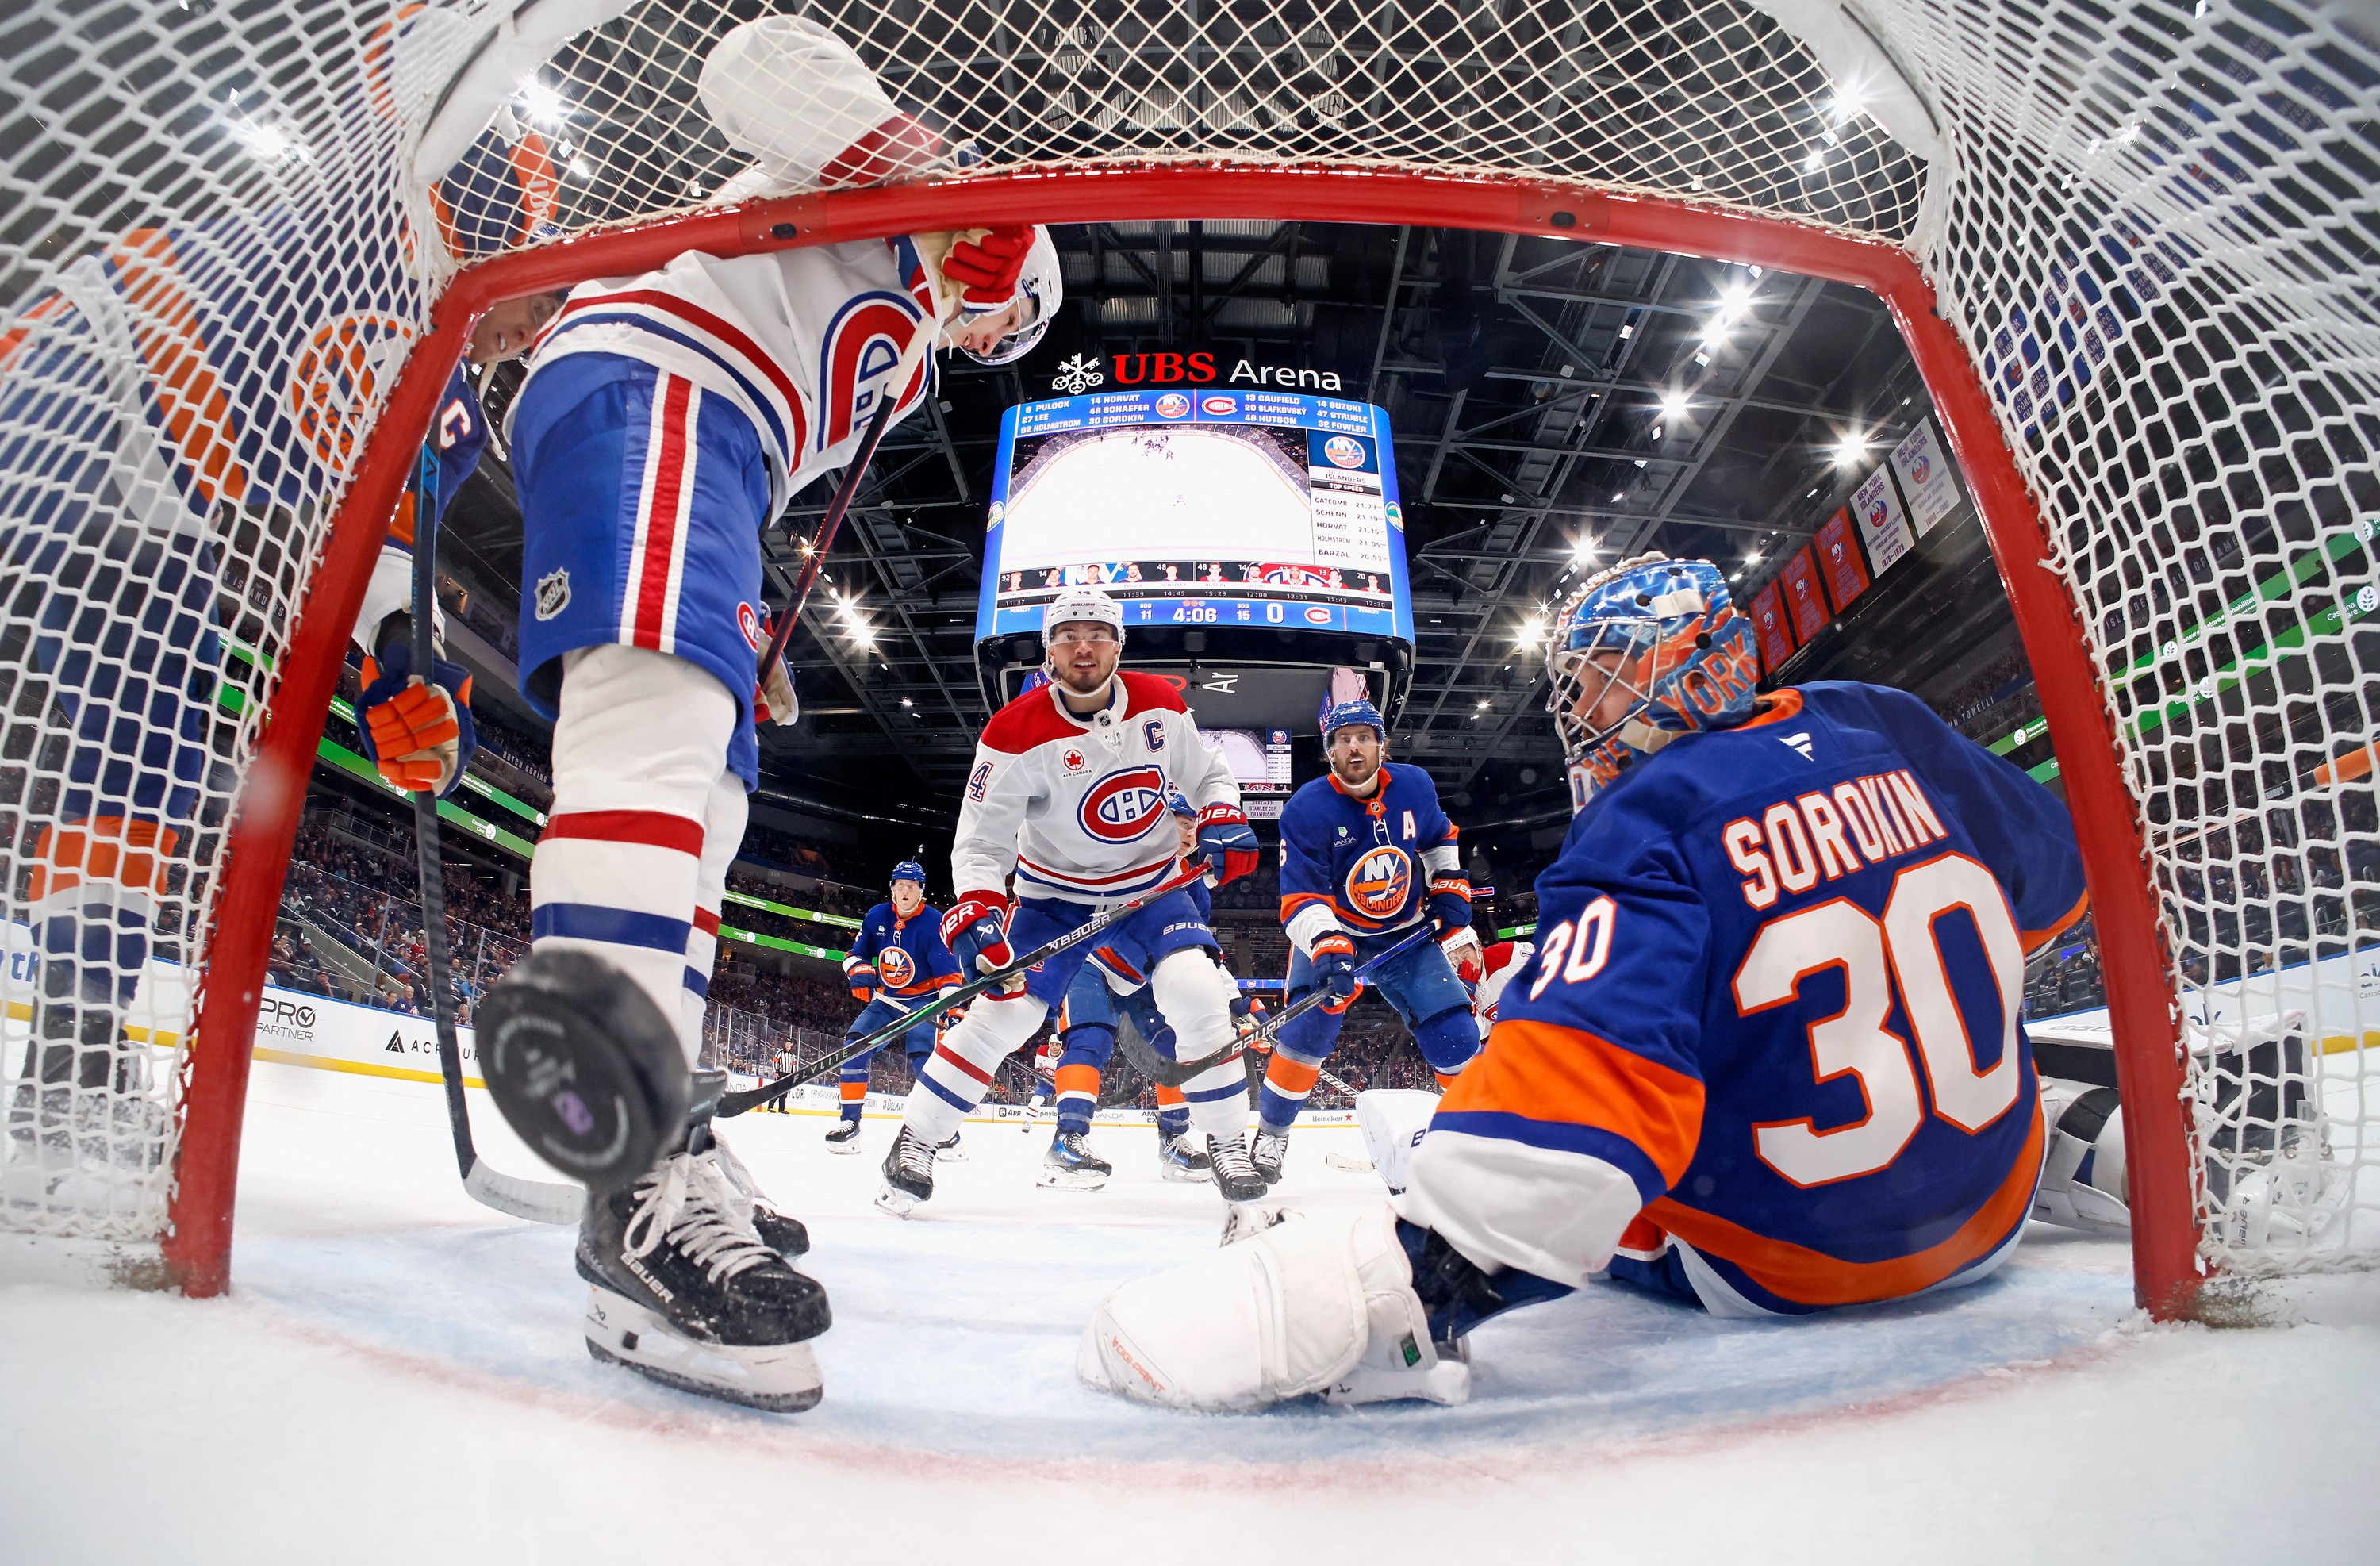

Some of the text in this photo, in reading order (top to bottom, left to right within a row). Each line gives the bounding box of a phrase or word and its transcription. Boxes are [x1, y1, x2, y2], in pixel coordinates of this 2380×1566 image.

[1112, 352, 1342, 391] UBS Arena
[1036, 401, 1069, 412] PULOCK
[1258, 395, 1300, 405] CAUFIELD
[1103, 405, 1150, 414] SCHAEFER
[1258, 405, 1307, 416] SLAFKOVSKÝ
[1330, 401, 1361, 413] SUZUKI
[440, 398, 471, 450] C
[1035, 413, 1049, 422] LEE
[1102, 414, 1144, 424] SOROKIN
[1259, 416, 1296, 424] HUTSON
[1330, 412, 1368, 424] STRUBLE
[1033, 419, 1081, 432] HOLMSTROM
[1331, 422, 1367, 433] FOWLER
[1326, 474, 1366, 484] ISLANDERS
[1315, 497, 1347, 506] GATCOMB
[1860, 482, 1885, 511] ISLANDERS
[1319, 549, 1350, 558] BARZAL
[2193, 558, 2206, 571] OF
[1141, 610, 1152, 620] 11
[1173, 608, 1217, 623] 4:06
[1237, 611, 1250, 620] 15
[1266, 603, 1284, 623] 0
[1657, 631, 1761, 731] YORK
[1142, 719, 1165, 754] C
[1403, 811, 1416, 841] A
[1333, 836, 1357, 847] VANDA
[1722, 769, 1948, 911] SOROKIN
[1365, 854, 1399, 881] NY
[1357, 886, 1405, 912] ISLANDERS
[1060, 914, 1111, 946] BAUER
[1530, 895, 1617, 1003] 30
[885, 950, 905, 965] NY
[1731, 850, 2025, 1190] 30
[793, 1049, 849, 1084] FLYLITE
[726, 1080, 747, 1092] ANDA
[620, 1252, 674, 1304] BAUER
